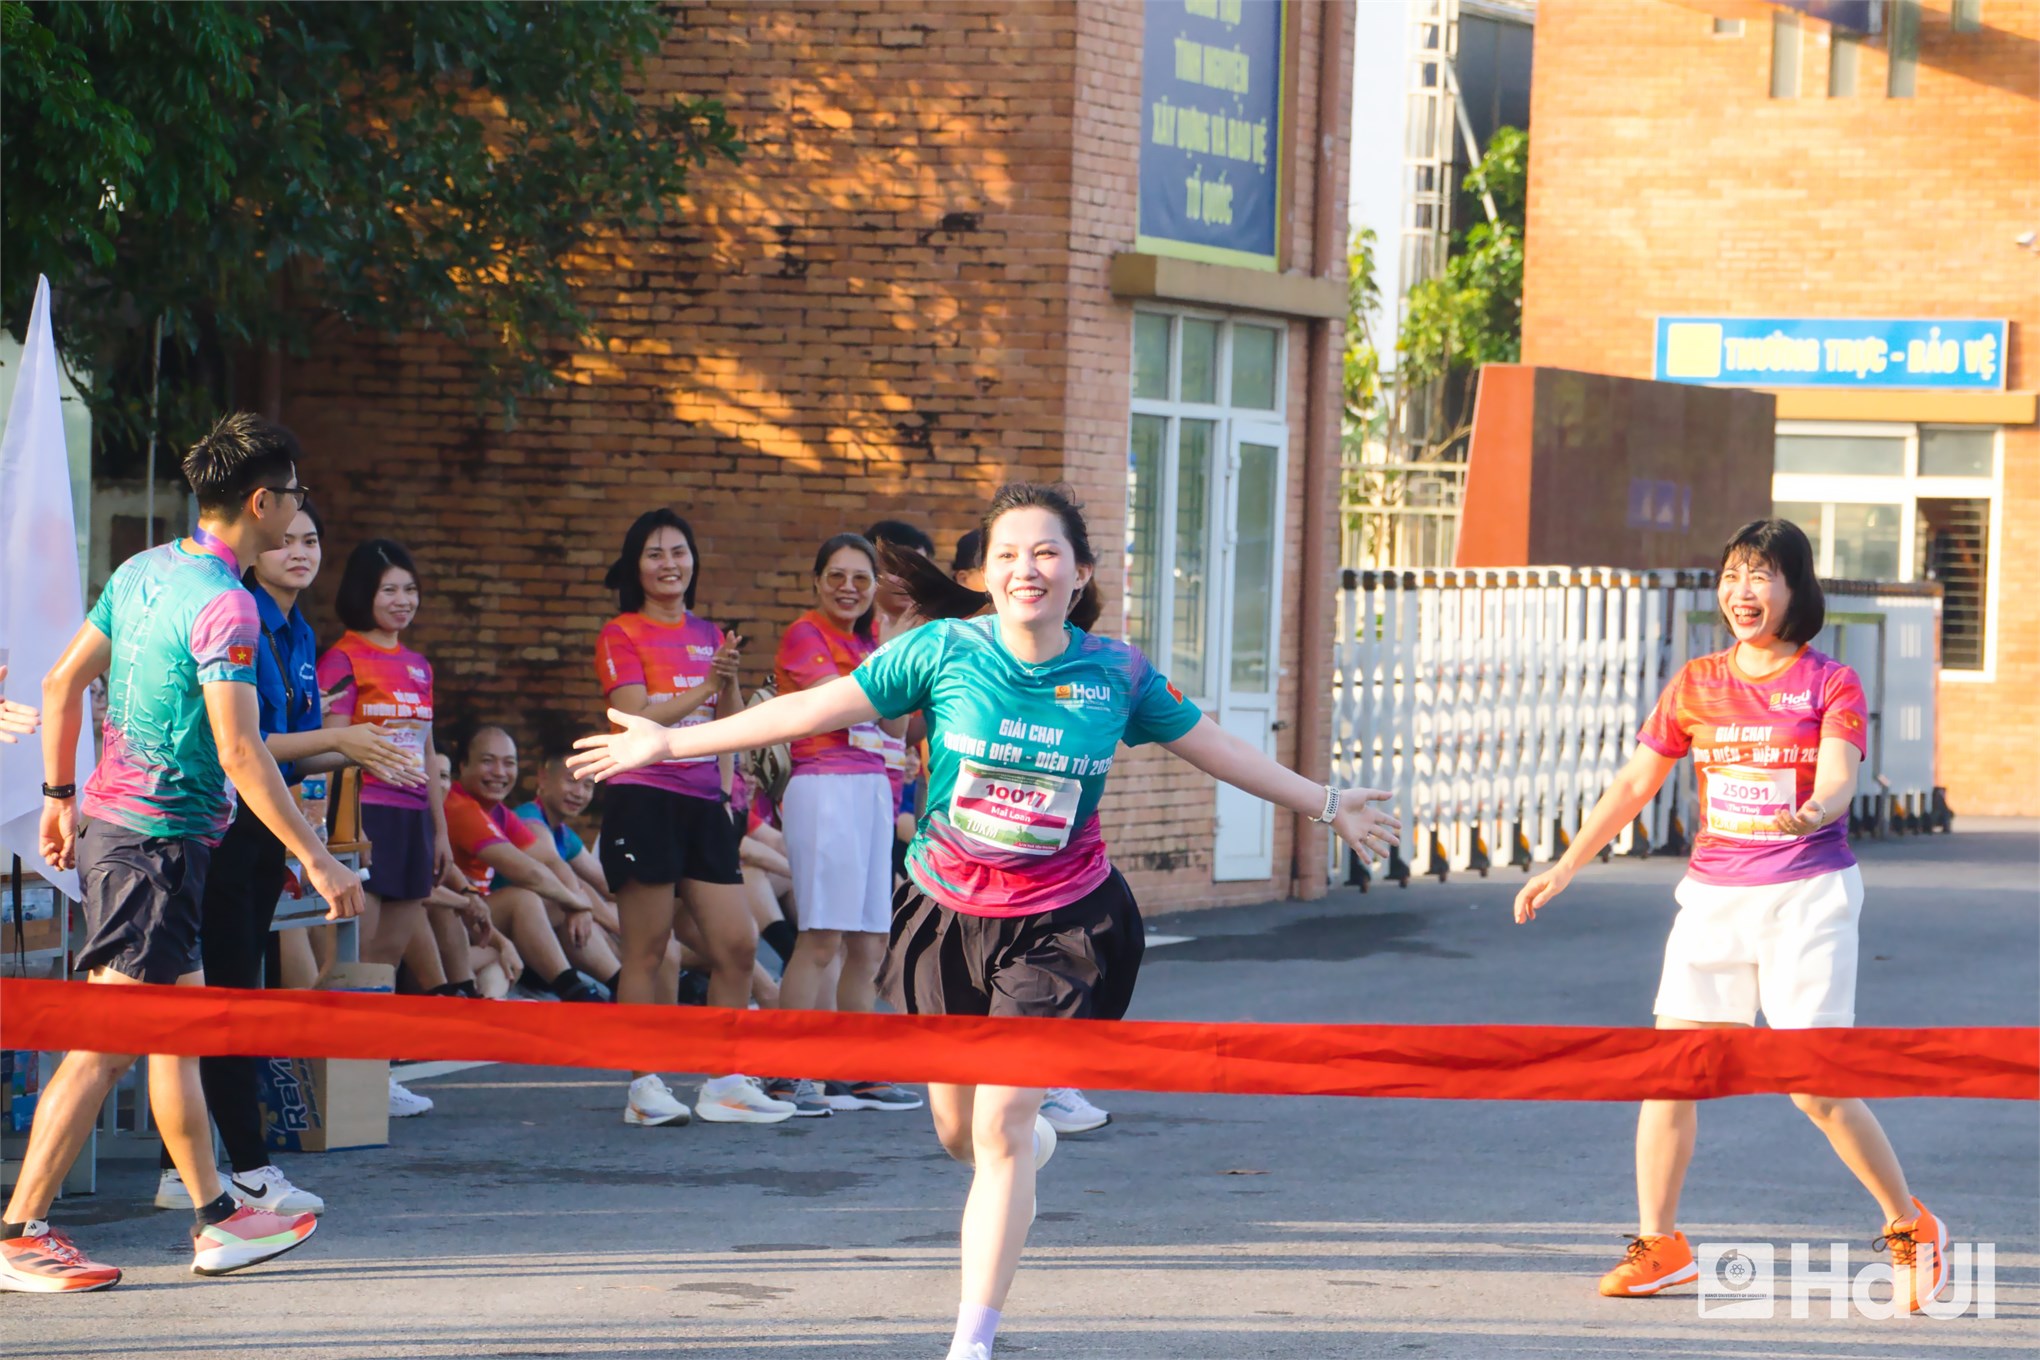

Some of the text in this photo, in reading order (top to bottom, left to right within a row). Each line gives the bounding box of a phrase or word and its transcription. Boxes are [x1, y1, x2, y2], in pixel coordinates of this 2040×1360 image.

[1907, 326, 1960, 374] BẢO
[1963, 333, 1996, 381] VỆ
[1072, 683, 1110, 701] HaUI
[999, 717, 1064, 748] GIẢI CHẠY
[1715, 722, 1773, 746] GIẢI CHẠY
[1783, 744, 1799, 763] TỬ
[1071, 754, 1090, 776] TỬ
[986, 783, 1047, 808] 10017
[1723, 782, 1769, 801] 25091
[991, 806, 1031, 822] Mai Loan
[967, 819, 998, 838] 10KM
